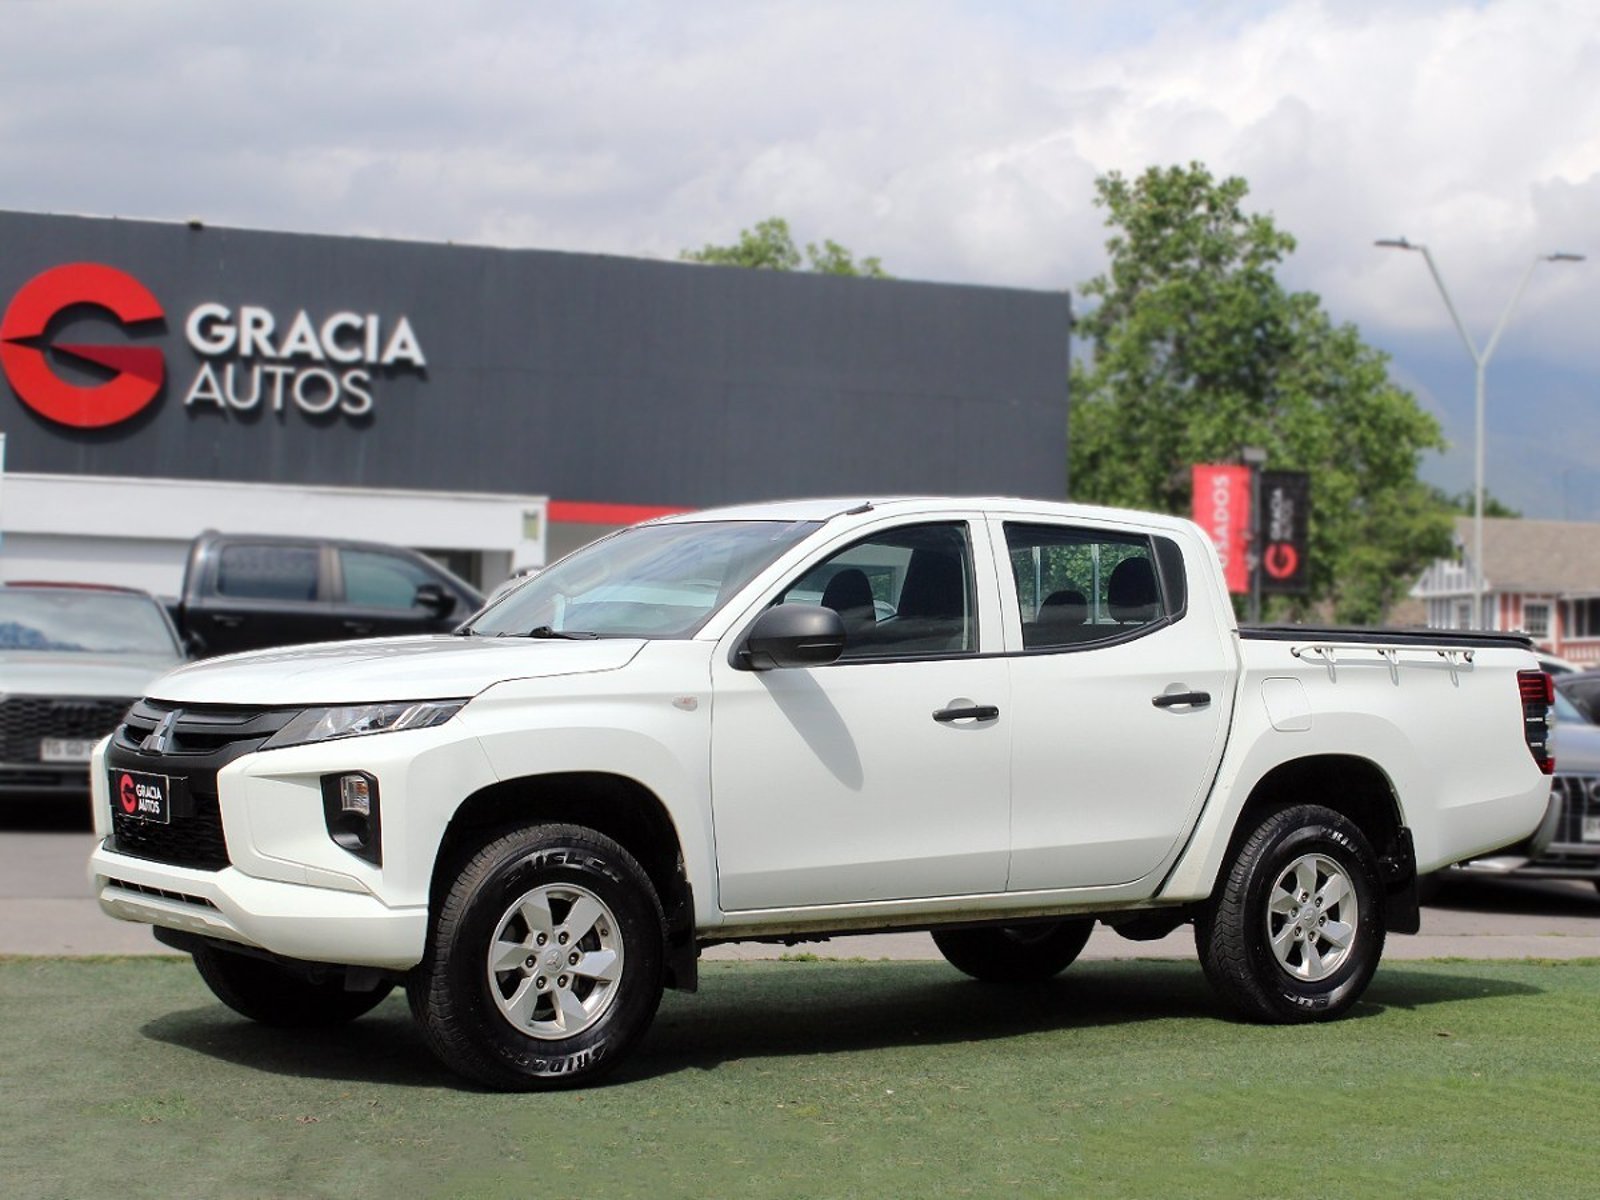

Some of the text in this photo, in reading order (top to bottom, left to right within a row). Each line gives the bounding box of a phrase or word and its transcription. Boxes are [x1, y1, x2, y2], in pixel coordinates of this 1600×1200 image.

[185, 302, 427, 367] GRACIA
[184, 360, 373, 415] AUTOS
[135, 783, 163, 801] GRACIA
[138, 798, 160, 815] AUTOS
